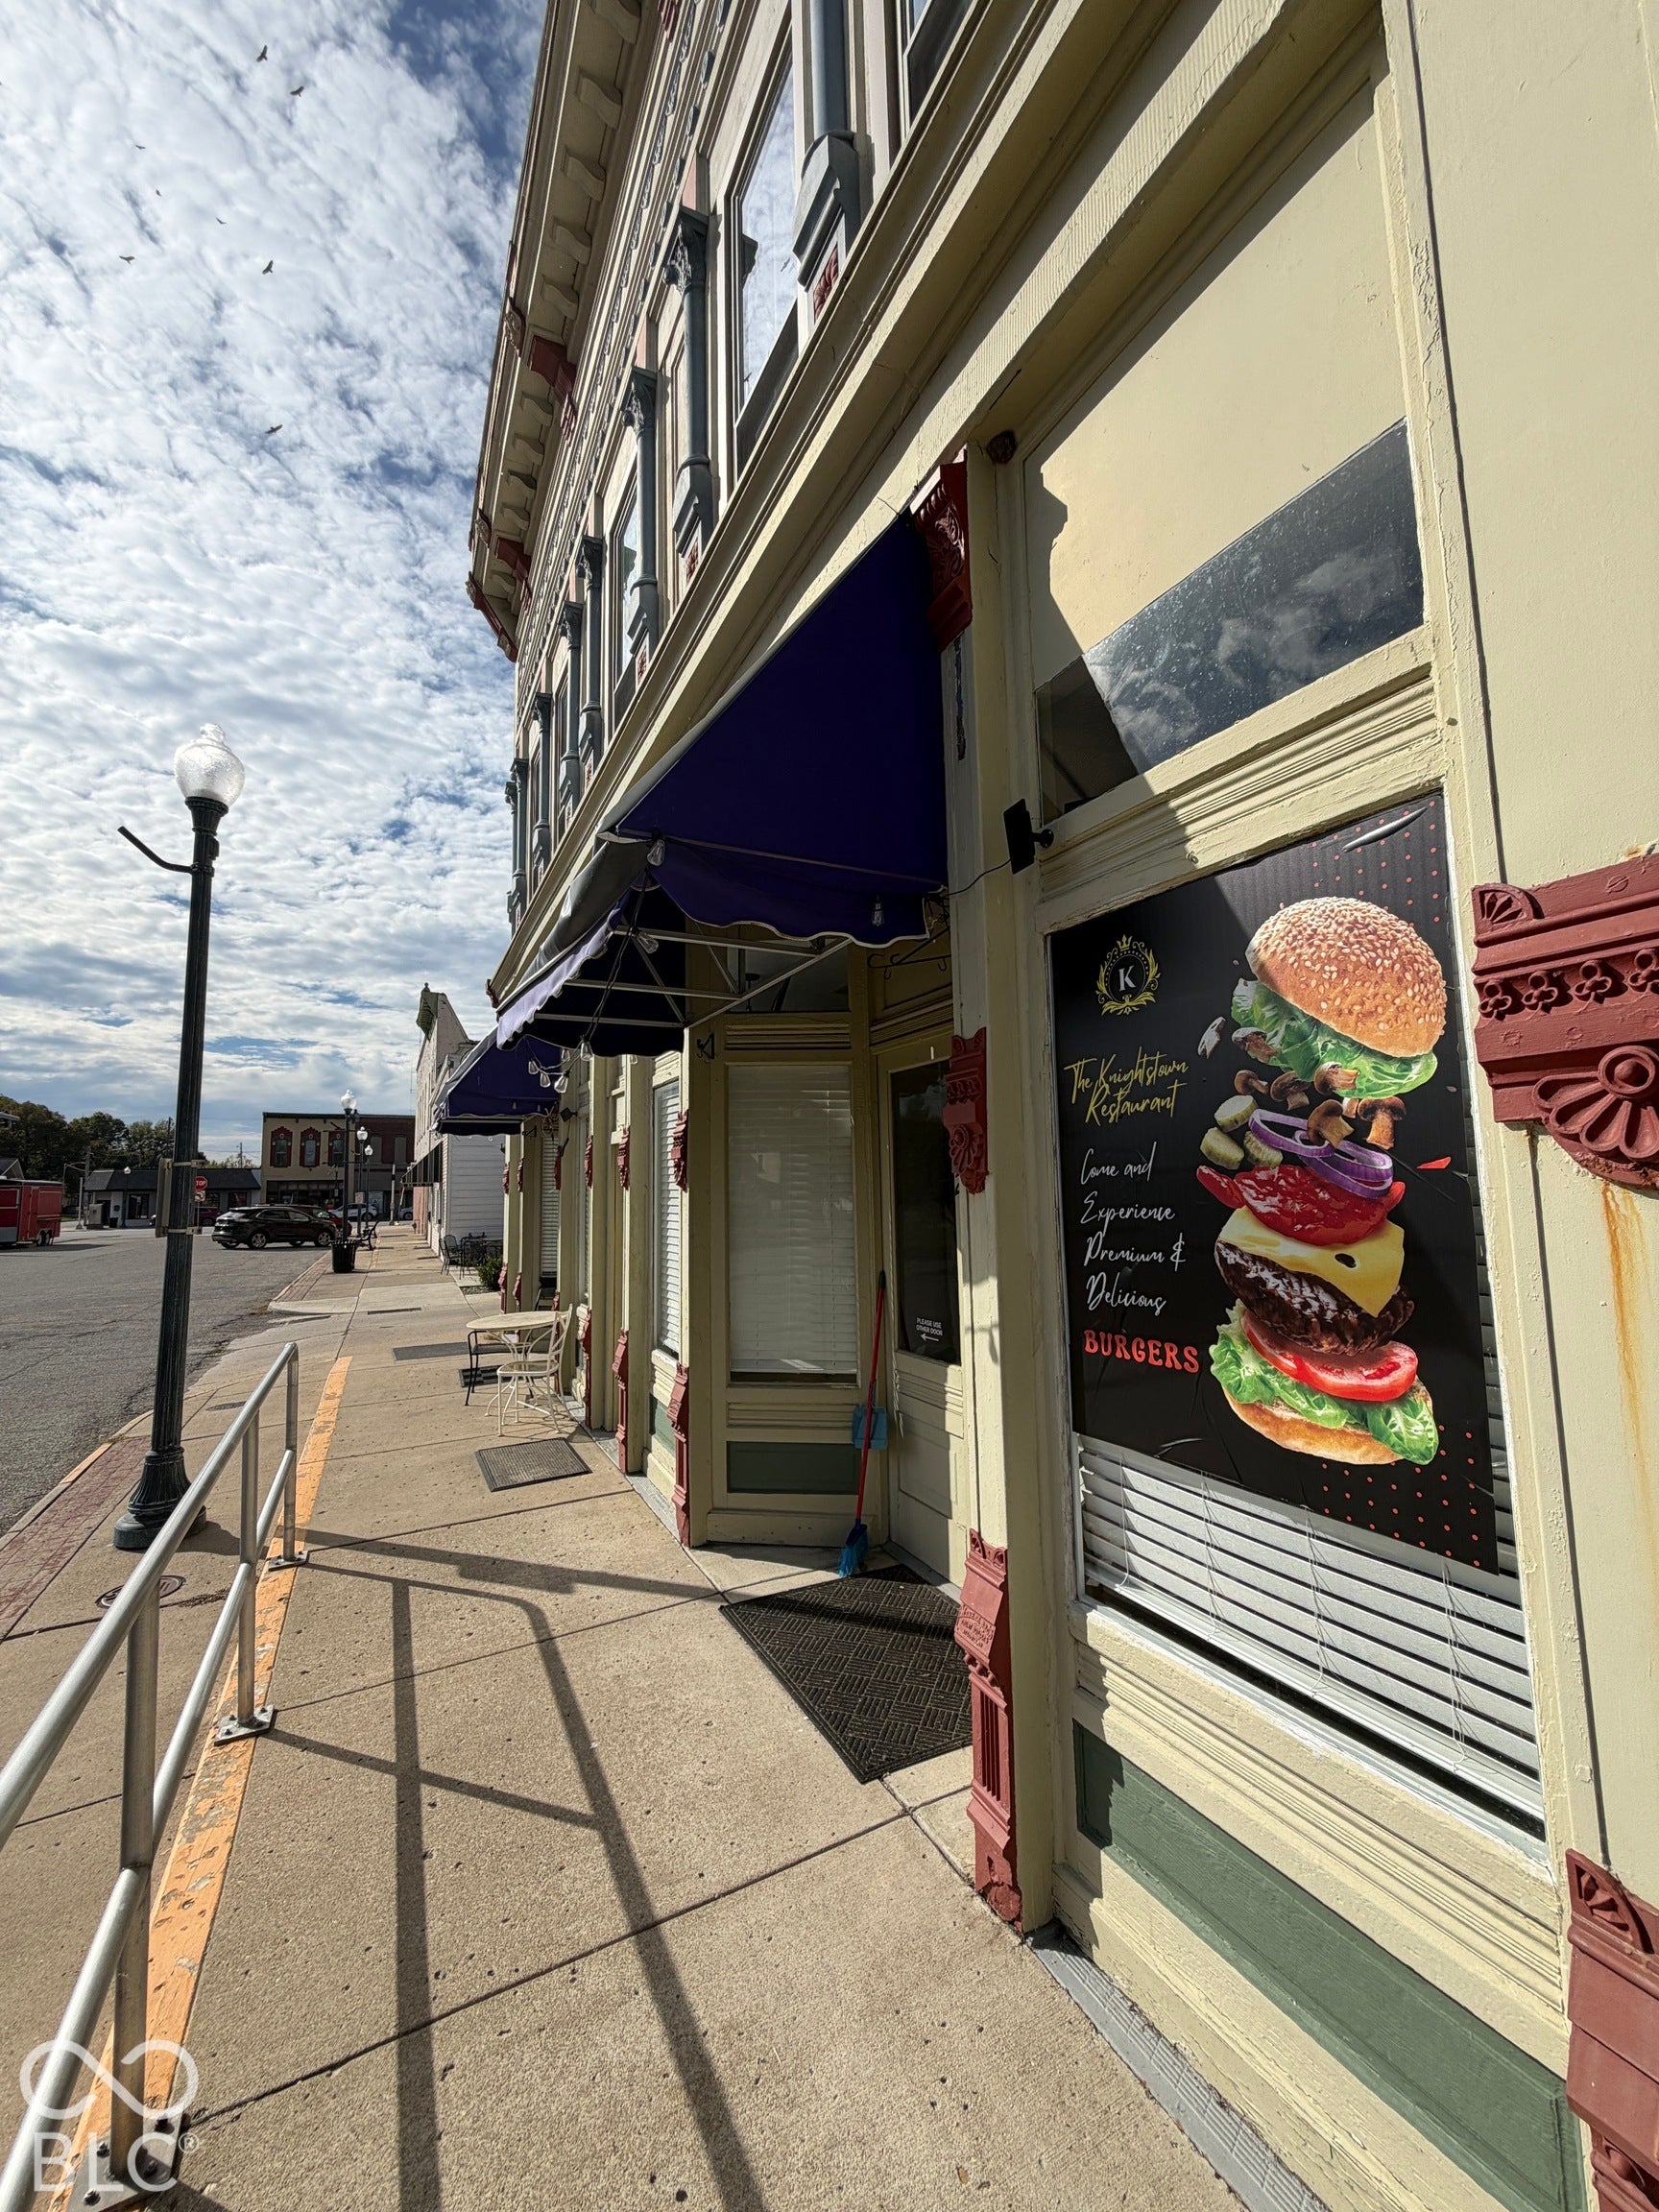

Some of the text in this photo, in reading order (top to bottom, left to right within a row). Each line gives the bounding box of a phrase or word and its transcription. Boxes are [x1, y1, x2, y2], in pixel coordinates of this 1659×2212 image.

[1118, 965, 1137, 992] K
[1064, 1046, 1189, 1104] The Knightstown
[1085, 1079, 1188, 1126] Restaurant
[1080, 1141, 1157, 1185] Come and
[1080, 1190, 1176, 1238] Experience
[1083, 1231, 1187, 1272] Premium &
[1086, 1271, 1166, 1316] Delicious
[916, 1317, 933, 1327] PLEASE
[1083, 1329, 1200, 1374] BURGERS
